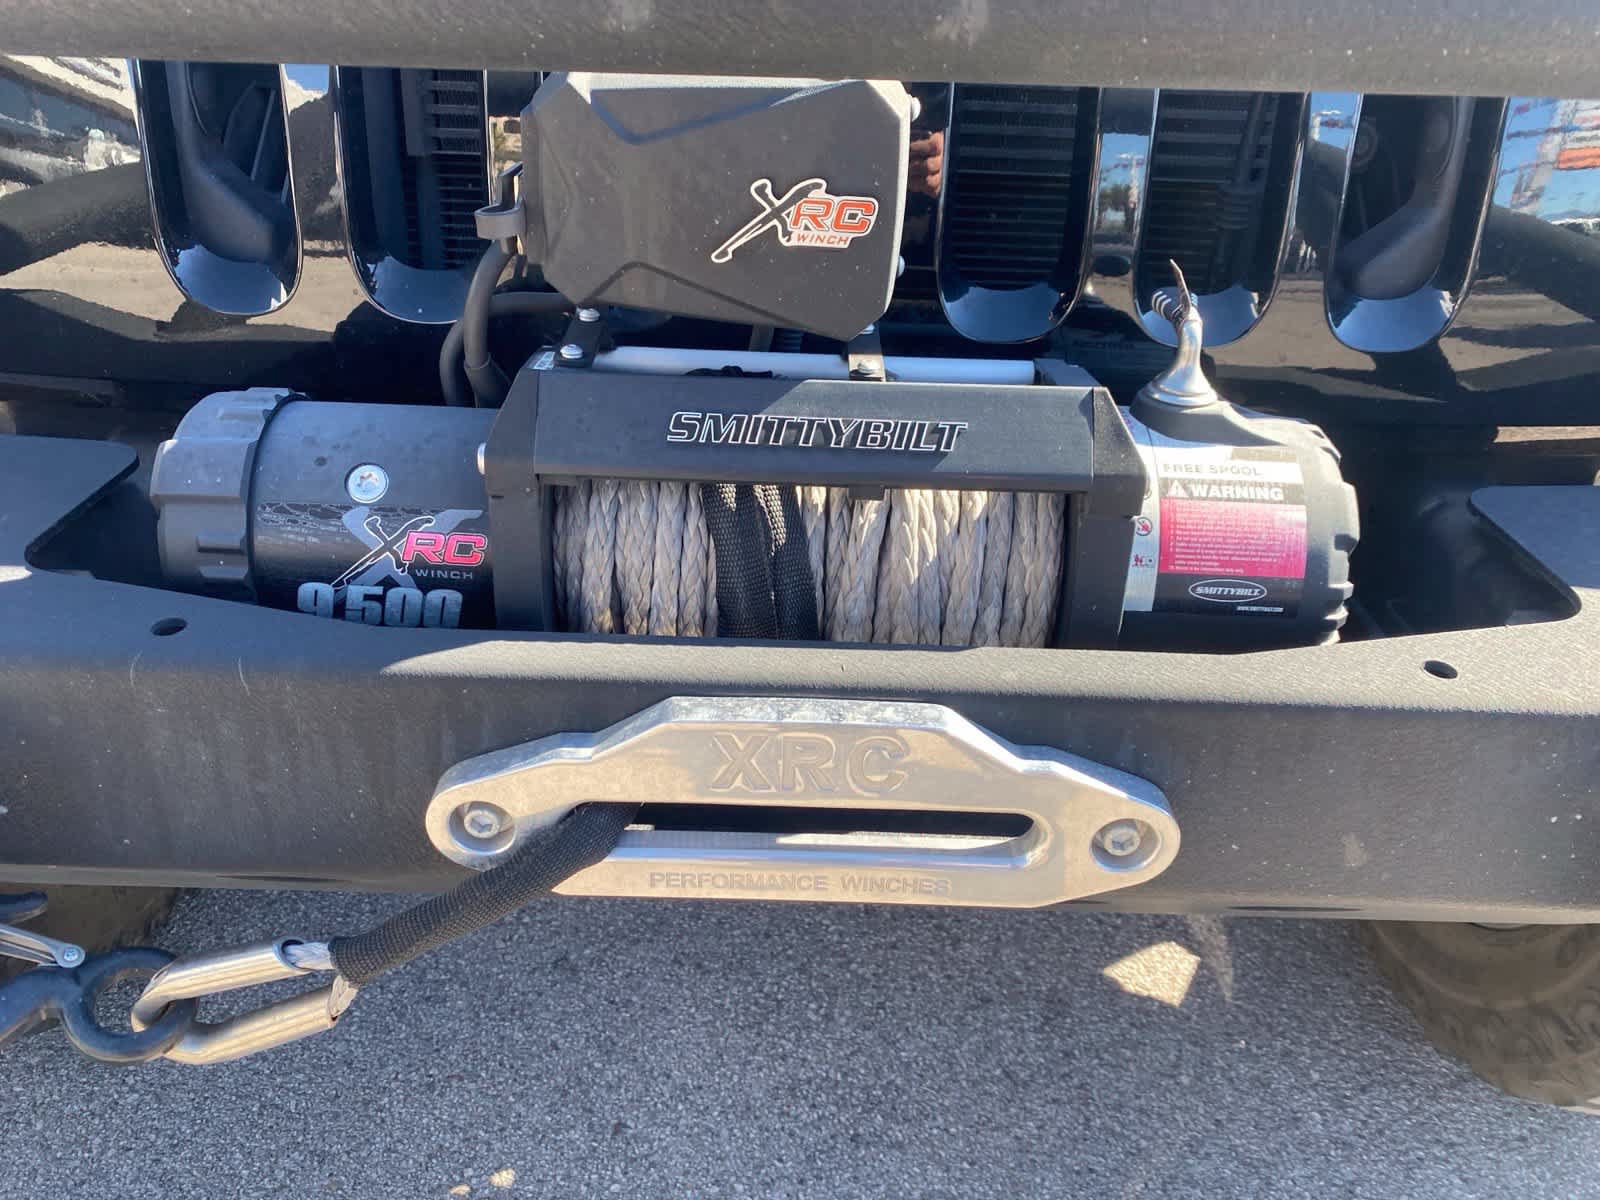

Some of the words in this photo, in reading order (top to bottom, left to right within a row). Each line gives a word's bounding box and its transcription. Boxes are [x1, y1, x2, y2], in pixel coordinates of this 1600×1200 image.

[711, 178, 879, 263] XRC
[797, 232, 850, 245] WINCH
[666, 411, 969, 452] SMITTYBILT
[1163, 463, 1202, 474] FREE
[1209, 464, 1264, 477] SPOOL
[1190, 484, 1284, 501] WARNING
[415, 568, 474, 580] WINCH
[709, 731, 911, 798] XRC
[649, 871, 828, 892] PERFORMANCE
[840, 874, 952, 897] WINCHES
